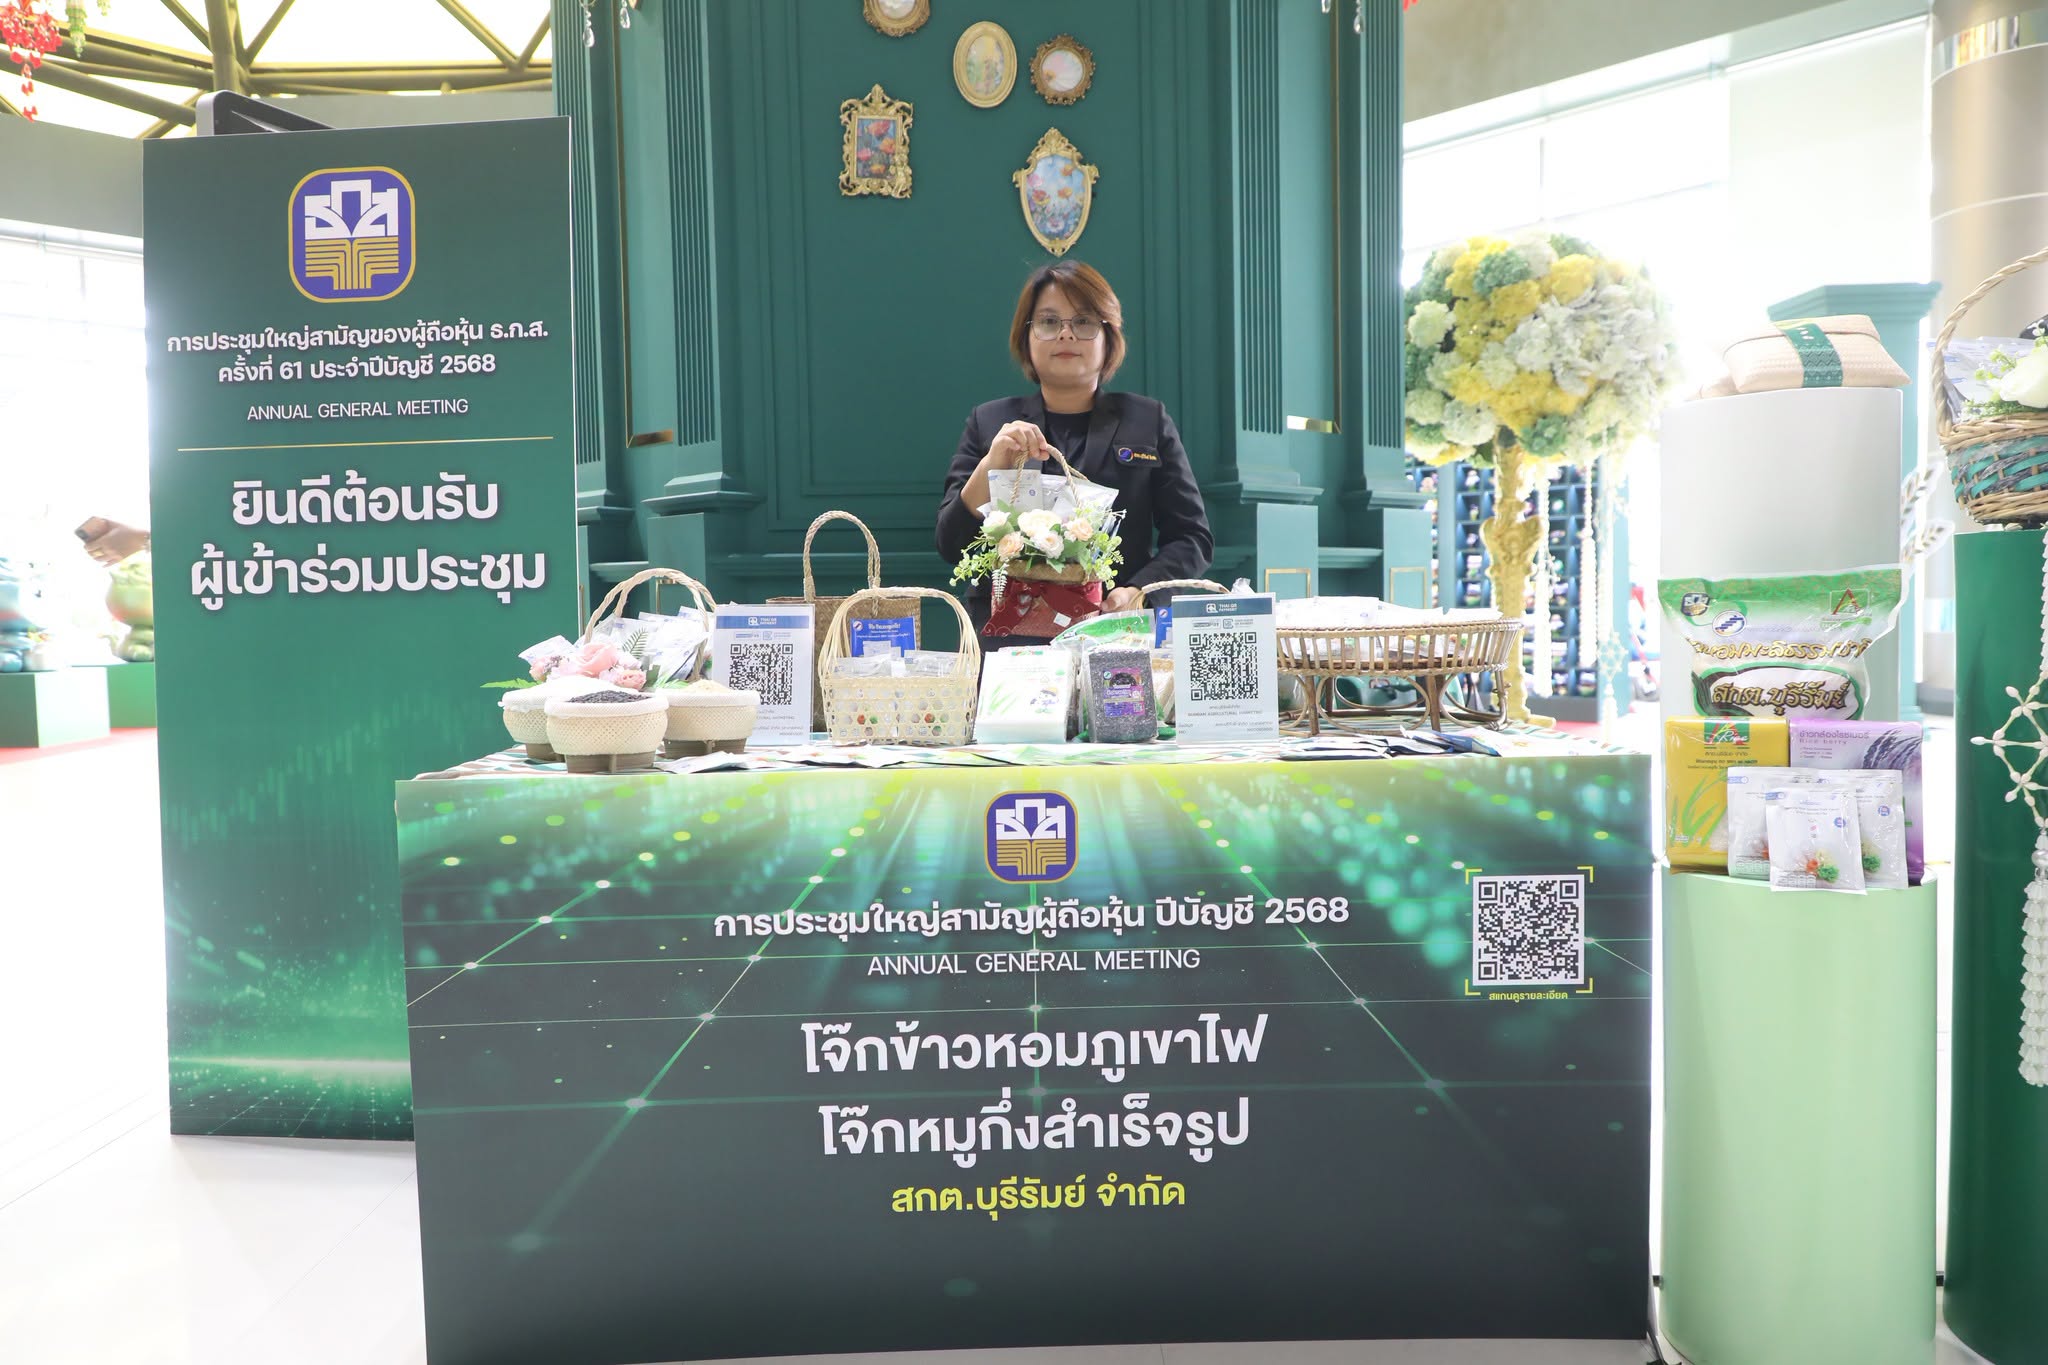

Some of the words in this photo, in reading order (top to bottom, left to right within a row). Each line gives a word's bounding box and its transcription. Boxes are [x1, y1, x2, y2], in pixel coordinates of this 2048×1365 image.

[166, 318, 484, 355] การประชุมใหญ่สามัญของผู้ถือหุ้น
[490, 320, 549, 340] ธ.ก.ส.
[218, 354, 274, 383] ครั้งที่
[279, 361, 303, 380] 61
[310, 353, 434, 379] ประจำปีบัญชี
[440, 353, 496, 374] 2568
[247, 404, 313, 421] ANNUAL
[317, 401, 392, 418] GENERAL
[397, 398, 469, 415] MEETING
[232, 469, 499, 526] ยินดีต้อนรับ
[191, 541, 546, 611] ผู้เข้าร่วมประชุม
[713, 895, 1146, 942] การประชุมใหญ่สามัญผู้ถือหุ้น
[1155, 893, 1255, 930] ปีบัญชี
[1265, 896, 1350, 924] 2568
[867, 954, 967, 976] ANNUAL
[975, 951, 1087, 974] GENERAL
[1095, 948, 1200, 970] MEETING
[800, 1013, 1269, 1083] โจ๊กข้าวหอมภูเขาไฟ
[818, 1087, 1250, 1169] โจ๊กหมูกึ่งสำเร็จรูป
[891, 1174, 1086, 1221] สกต.บุรีรัมย์
[1096, 1172, 1186, 1207] จำกัด
